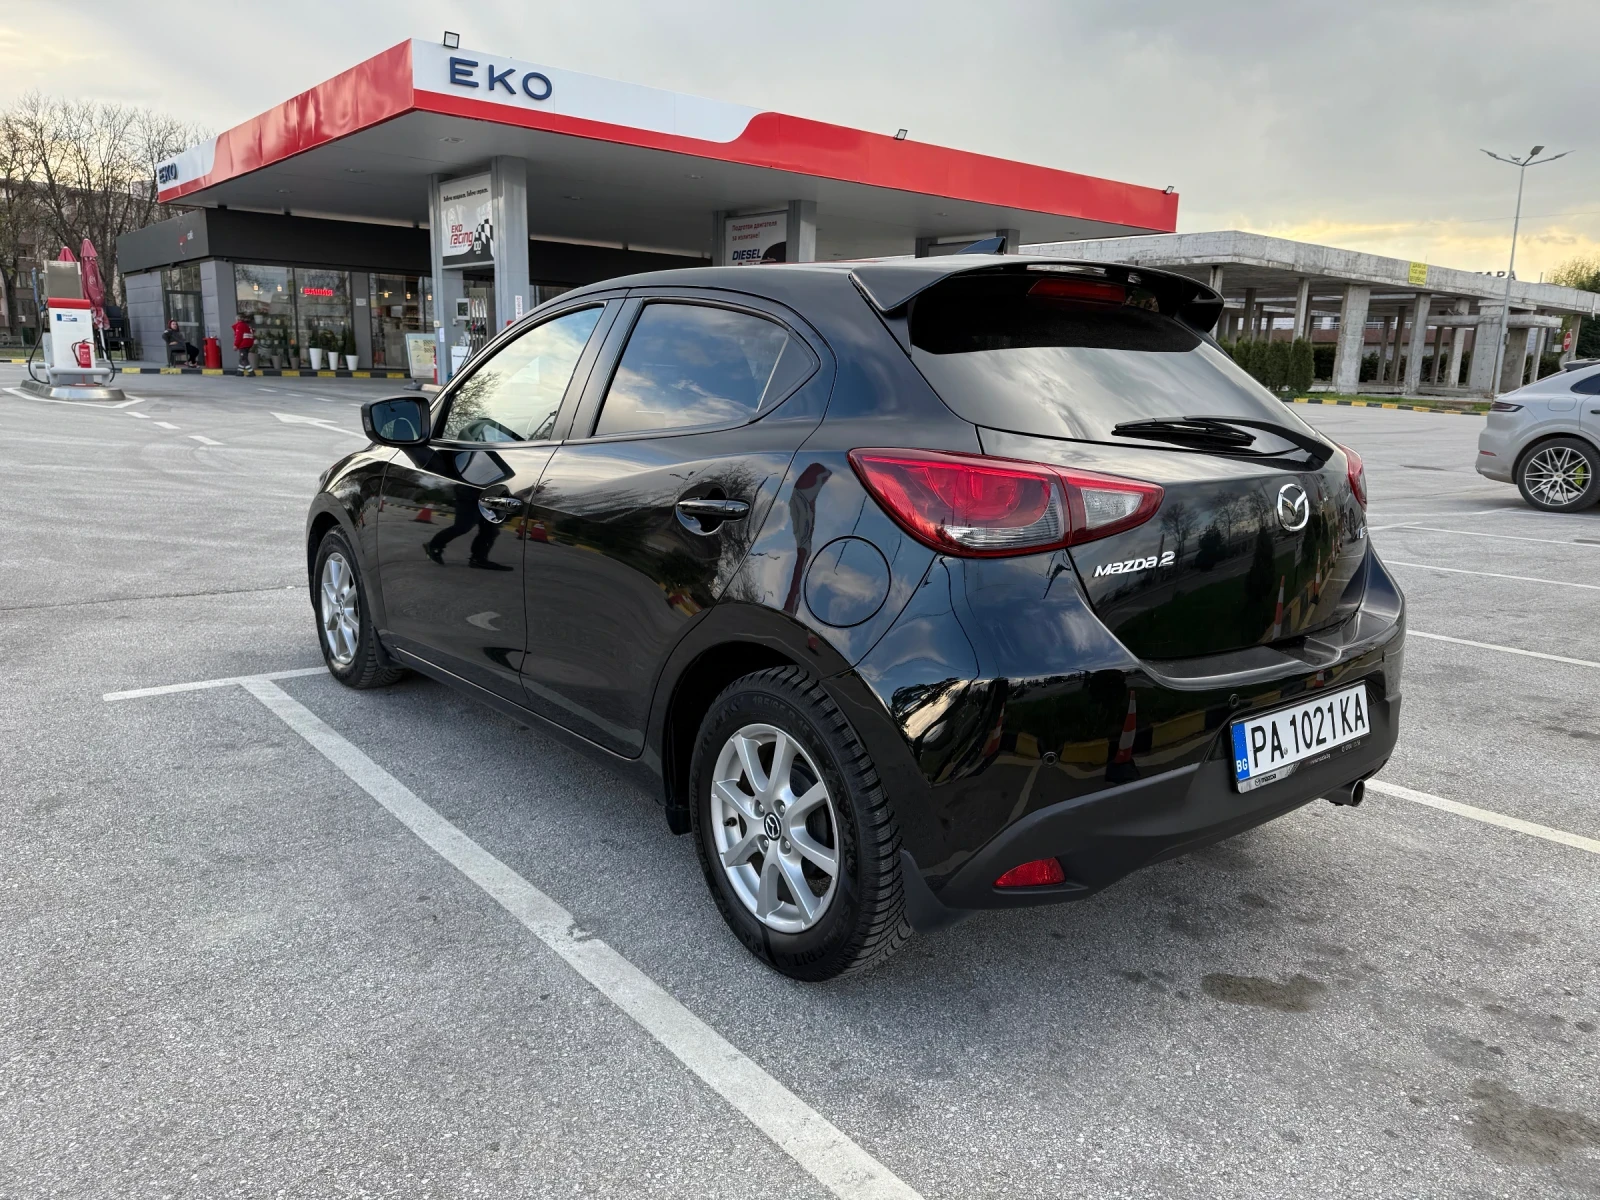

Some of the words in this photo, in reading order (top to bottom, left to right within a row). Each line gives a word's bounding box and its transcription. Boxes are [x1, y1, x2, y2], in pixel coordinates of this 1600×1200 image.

[449, 56, 552, 100] EKO
[158, 162, 178, 184] EKO
[450, 232, 473, 246] racing
[732, 249, 761, 261] DIESEL
[1251, 721, 1284, 768] PA
[1290, 702, 1337, 755] 1021
[1237, 758, 1248, 773] BG
